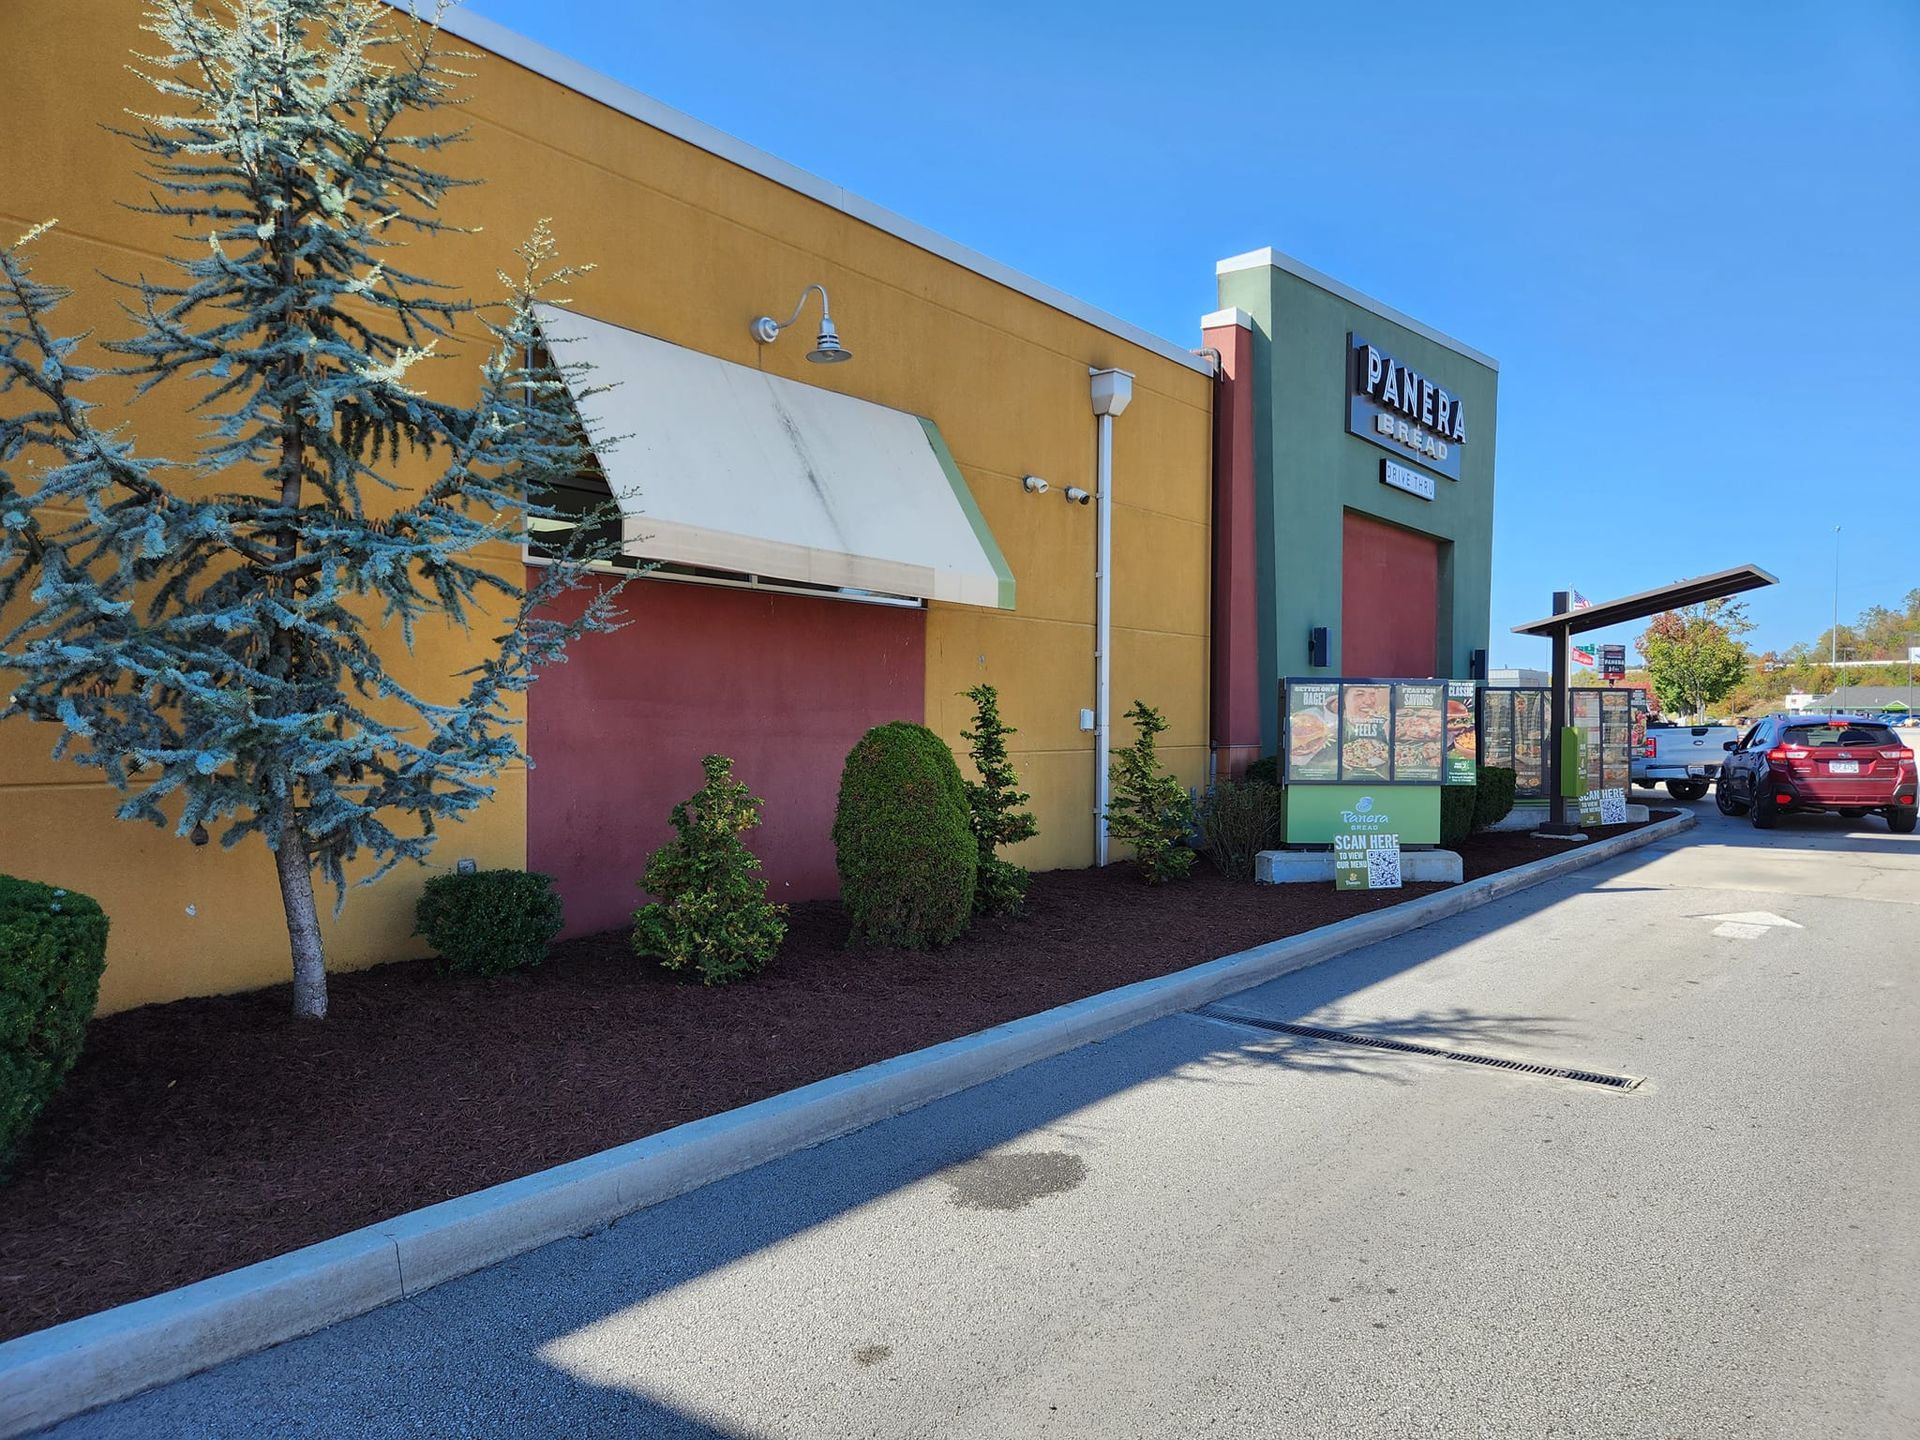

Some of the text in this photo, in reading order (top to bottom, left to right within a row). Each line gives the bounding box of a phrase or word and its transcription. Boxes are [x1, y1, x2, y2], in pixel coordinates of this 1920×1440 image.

[1361, 344, 1467, 444] PANERA
[1378, 413, 1448, 461] BREAD
[1386, 464, 1435, 497] DRIVE THRU
[1448, 686, 1474, 697] CLASSIC
[1303, 692, 1327, 706] BAGEL
[1403, 693, 1434, 706] SAVINGS
[1601, 787, 1625, 799] HERE
[1340, 810, 1389, 823] Panera
[1335, 833, 1400, 850] SCAN HERE
[1339, 851, 1364, 860] TO VIEW
[1336, 860, 1368, 869] OUR MENU
